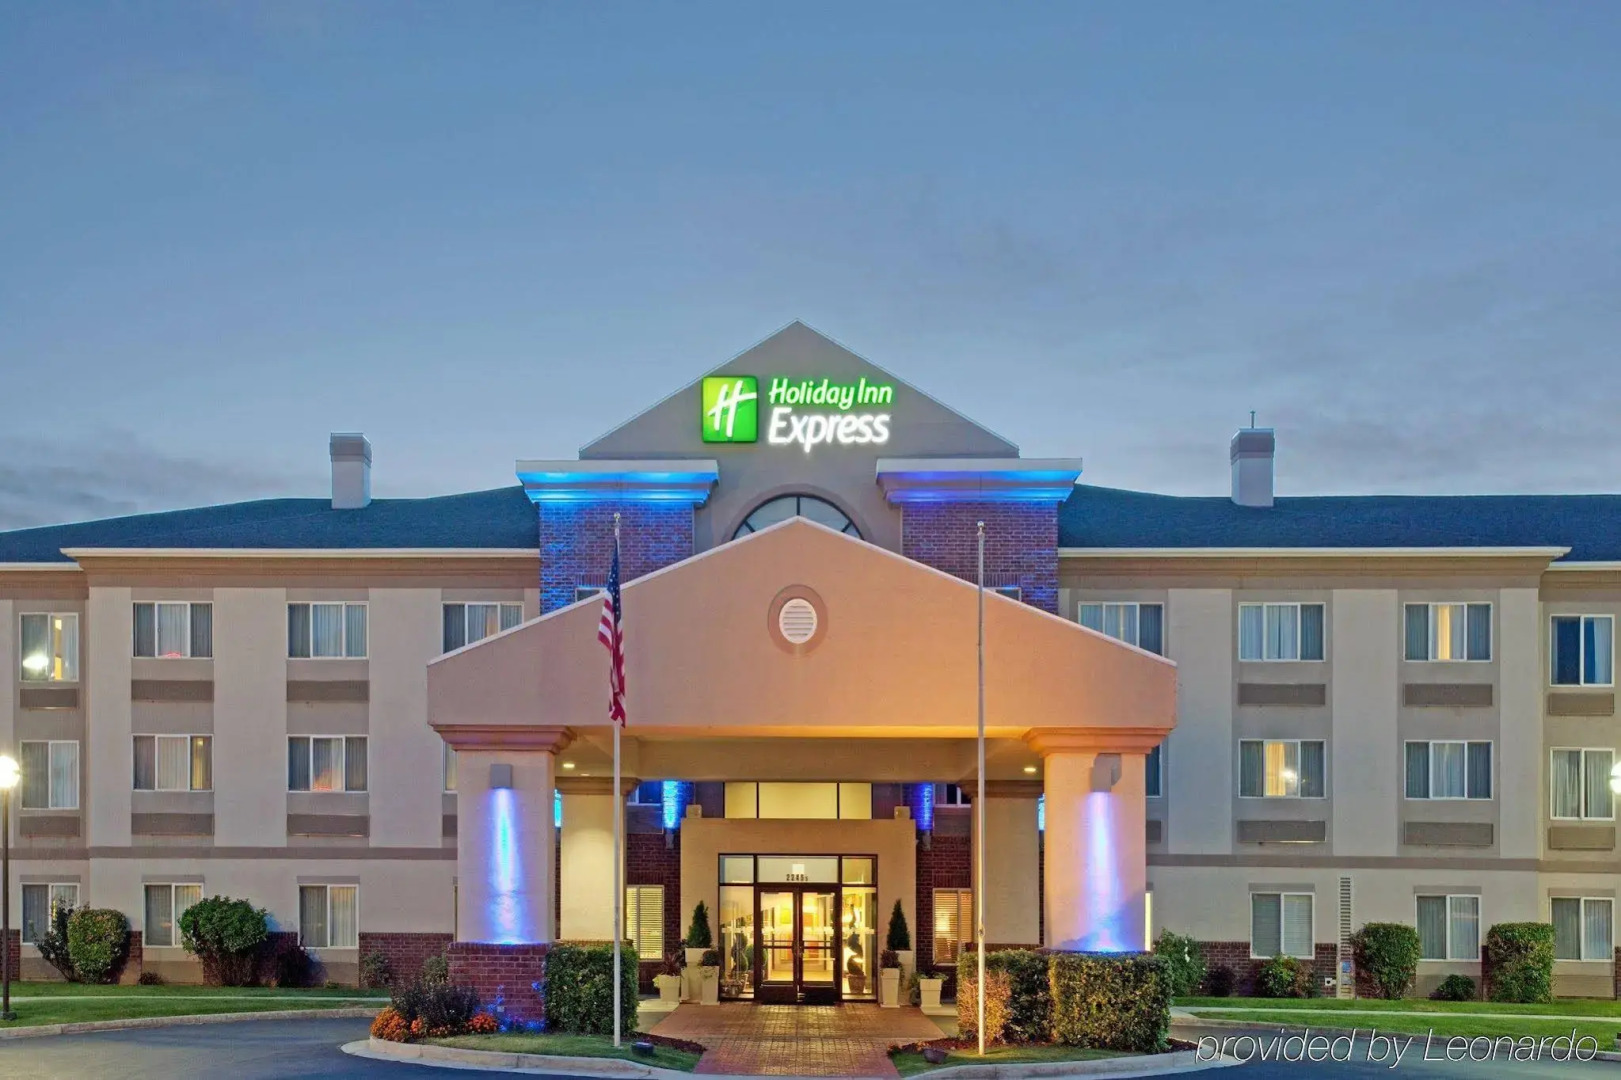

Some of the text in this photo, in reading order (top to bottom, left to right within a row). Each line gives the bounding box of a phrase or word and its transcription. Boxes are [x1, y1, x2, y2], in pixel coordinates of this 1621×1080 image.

[768, 378, 892, 410] Holiday Inn
[768, 407, 890, 453] Express
